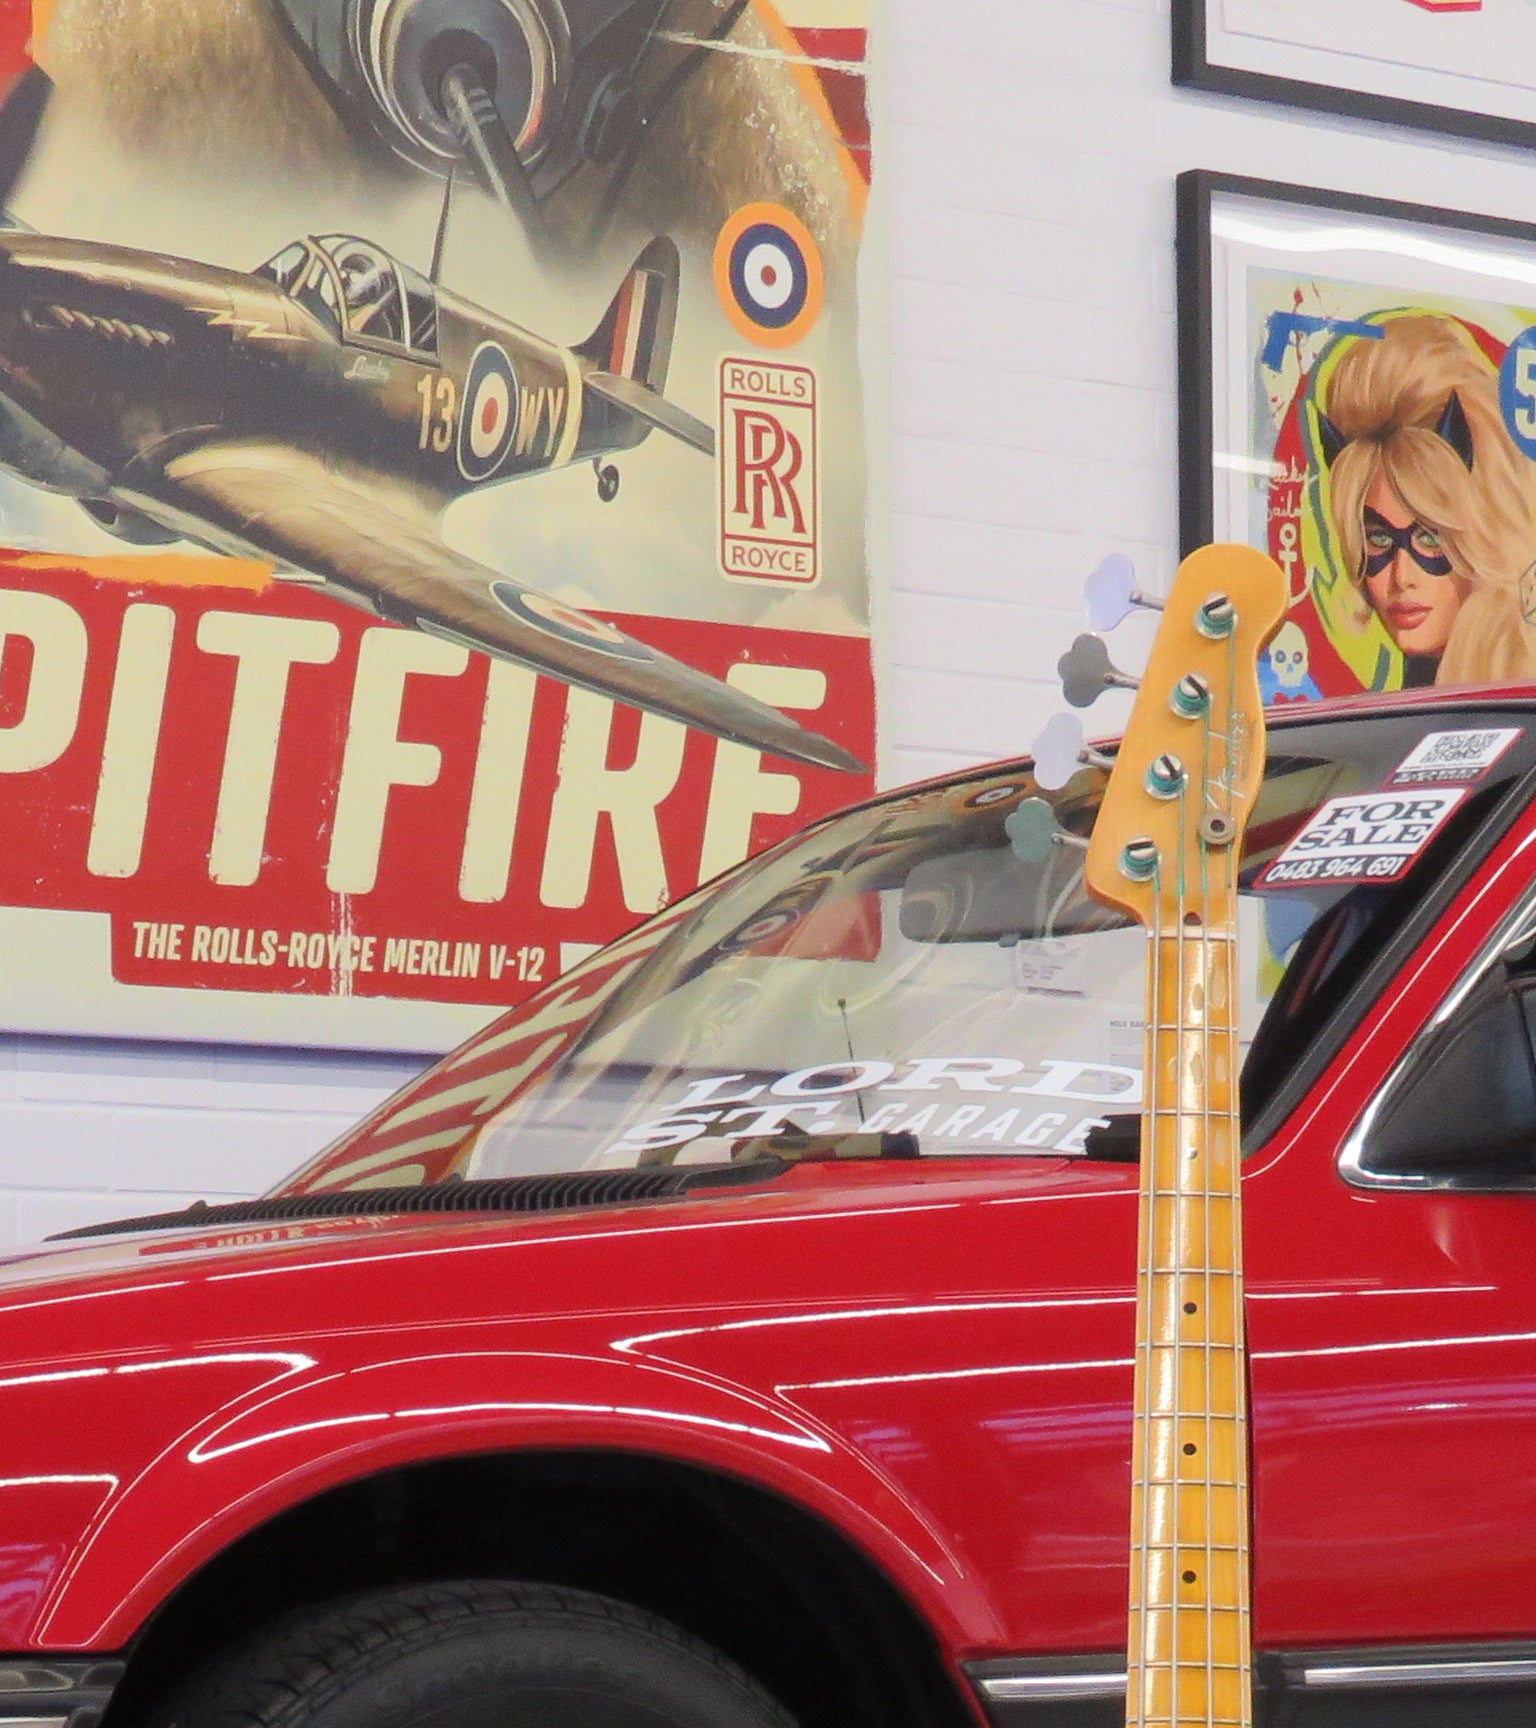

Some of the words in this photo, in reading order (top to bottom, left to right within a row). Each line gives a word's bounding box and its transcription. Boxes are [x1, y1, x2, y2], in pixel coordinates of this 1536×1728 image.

[730, 368, 807, 398] ROLLS
[417, 374, 456, 452] 13
[515, 386, 564, 457] WY
[731, 545, 807, 573] ROYCE
[1317, 799, 1446, 827] FOR
[1293, 823, 1433, 851] SALE
[1265, 859, 1320, 882] 0483
[1320, 856, 1364, 878] 964
[1366, 855, 1407, 876] 691
[133, 921, 182, 960] THE
[191, 924, 375, 972] ROLLS-ROYCE
[383, 936, 480, 979] MERLIN
[488, 945, 545, 982] V-12
[660, 1057, 1144, 1112] LORD
[604, 1100, 836, 1155] ST.
[859, 1102, 1112, 1155] GARAGE
